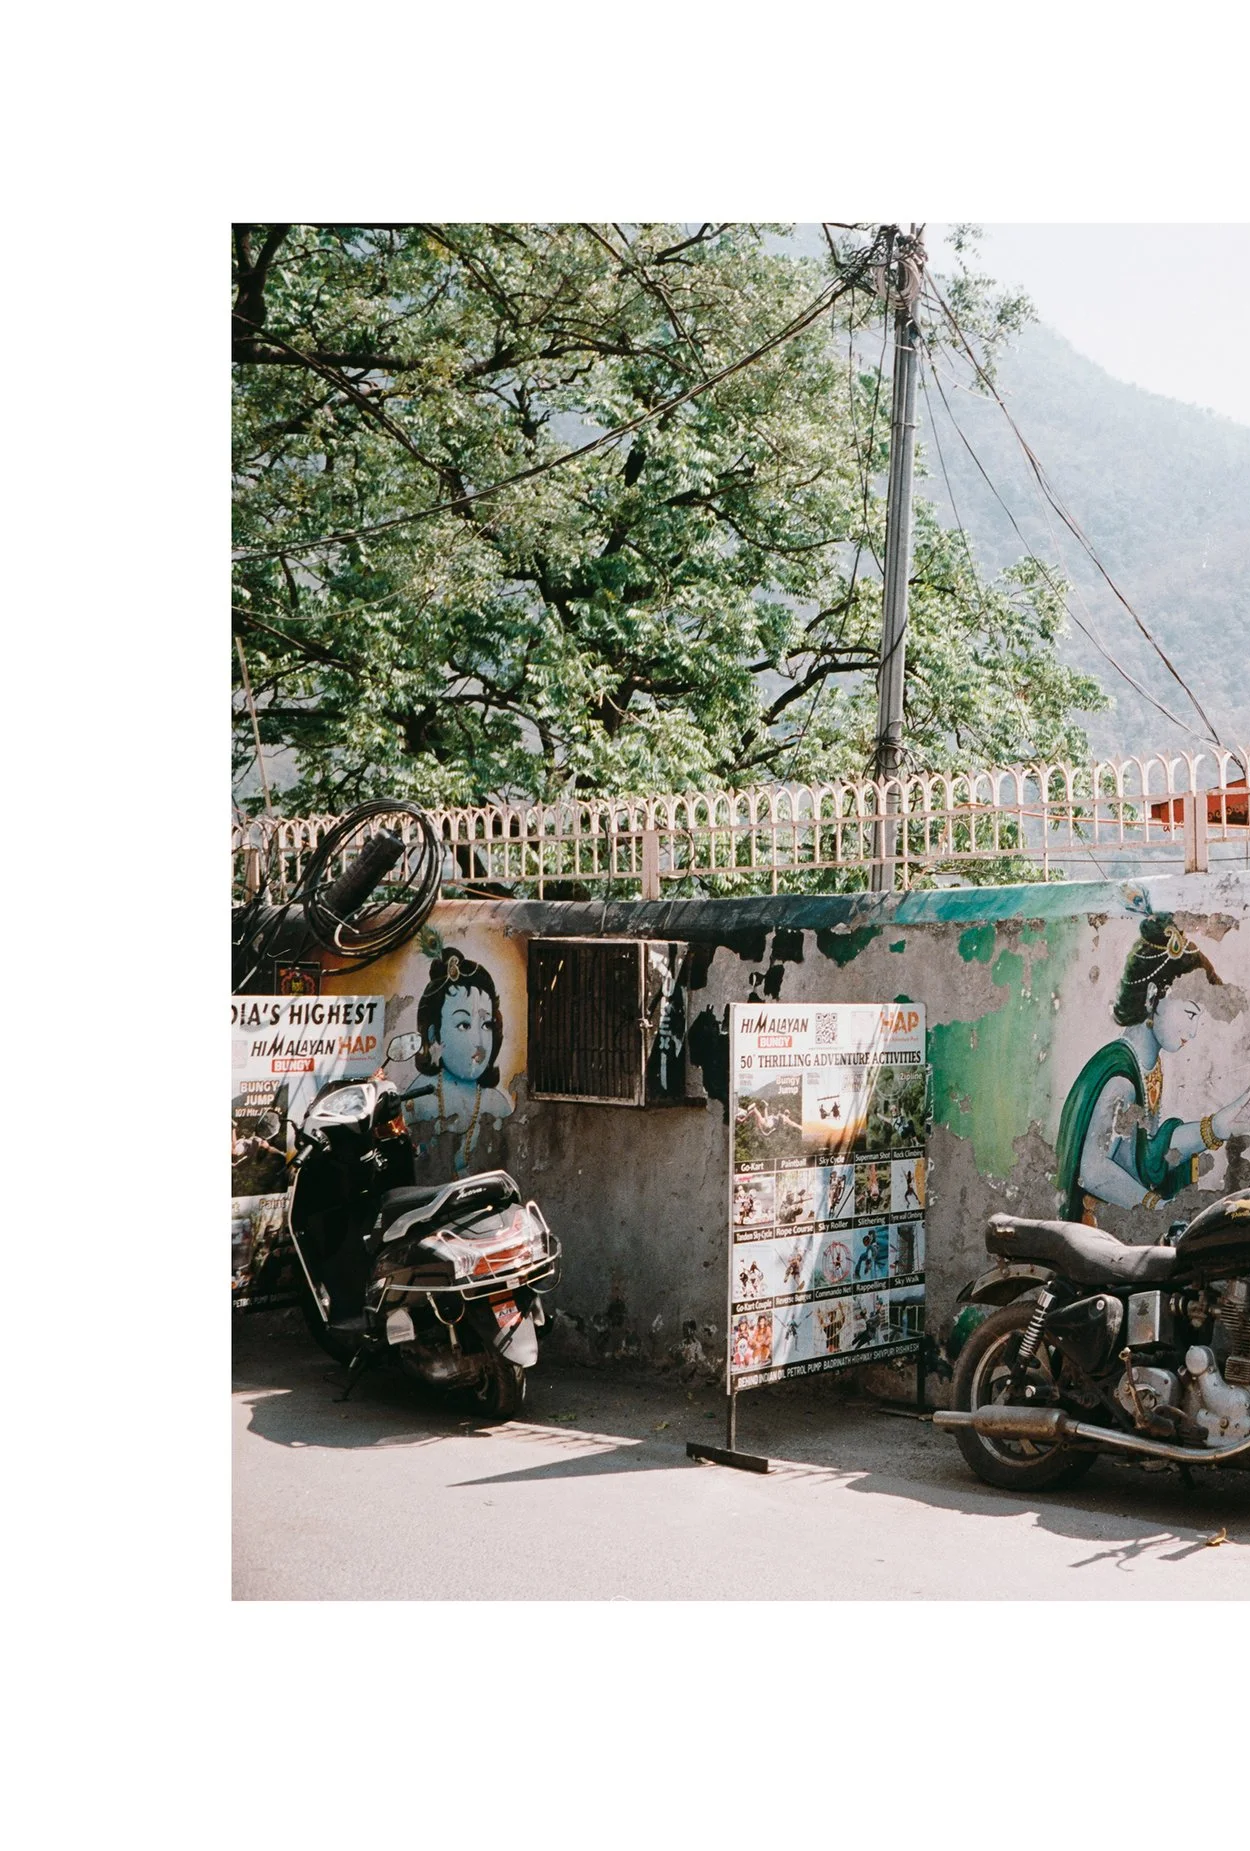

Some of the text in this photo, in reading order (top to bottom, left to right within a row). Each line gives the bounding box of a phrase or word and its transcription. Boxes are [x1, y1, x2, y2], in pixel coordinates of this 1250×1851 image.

[289, 1002, 378, 1025] HIGHEST
[740, 1009, 808, 1034] HIMALAYAN
[880, 1011, 919, 1033] HAP
[251, 1031, 377, 1058] HIMALAYAN HAP
[274, 1059, 312, 1072] BUNGY
[758, 1054, 811, 1068] THRILLING
[814, 1052, 870, 1066] ADVENTURE
[872, 1051, 921, 1064] ACTIVITIES
[776, 1074, 799, 1085] Bungy
[240, 1080, 280, 1093] BUNGY
[778, 1086, 798, 1094] Jump
[244, 1094, 274, 1106] JUMP
[781, 1158, 806, 1168] Paintball
[819, 1156, 845, 1165] Sky Cycle
[856, 1153, 879, 1161] Superman
[818, 1223, 829, 1231] Sky
[857, 1217, 885, 1226] Slithering
[776, 1224, 813, 1236] Rope Course
[856, 1281, 886, 1290] Rappelling
[816, 1288, 841, 1298] Commando
[787, 1365, 806, 1377] PETROL
[808, 1362, 821, 1373] PUMP
